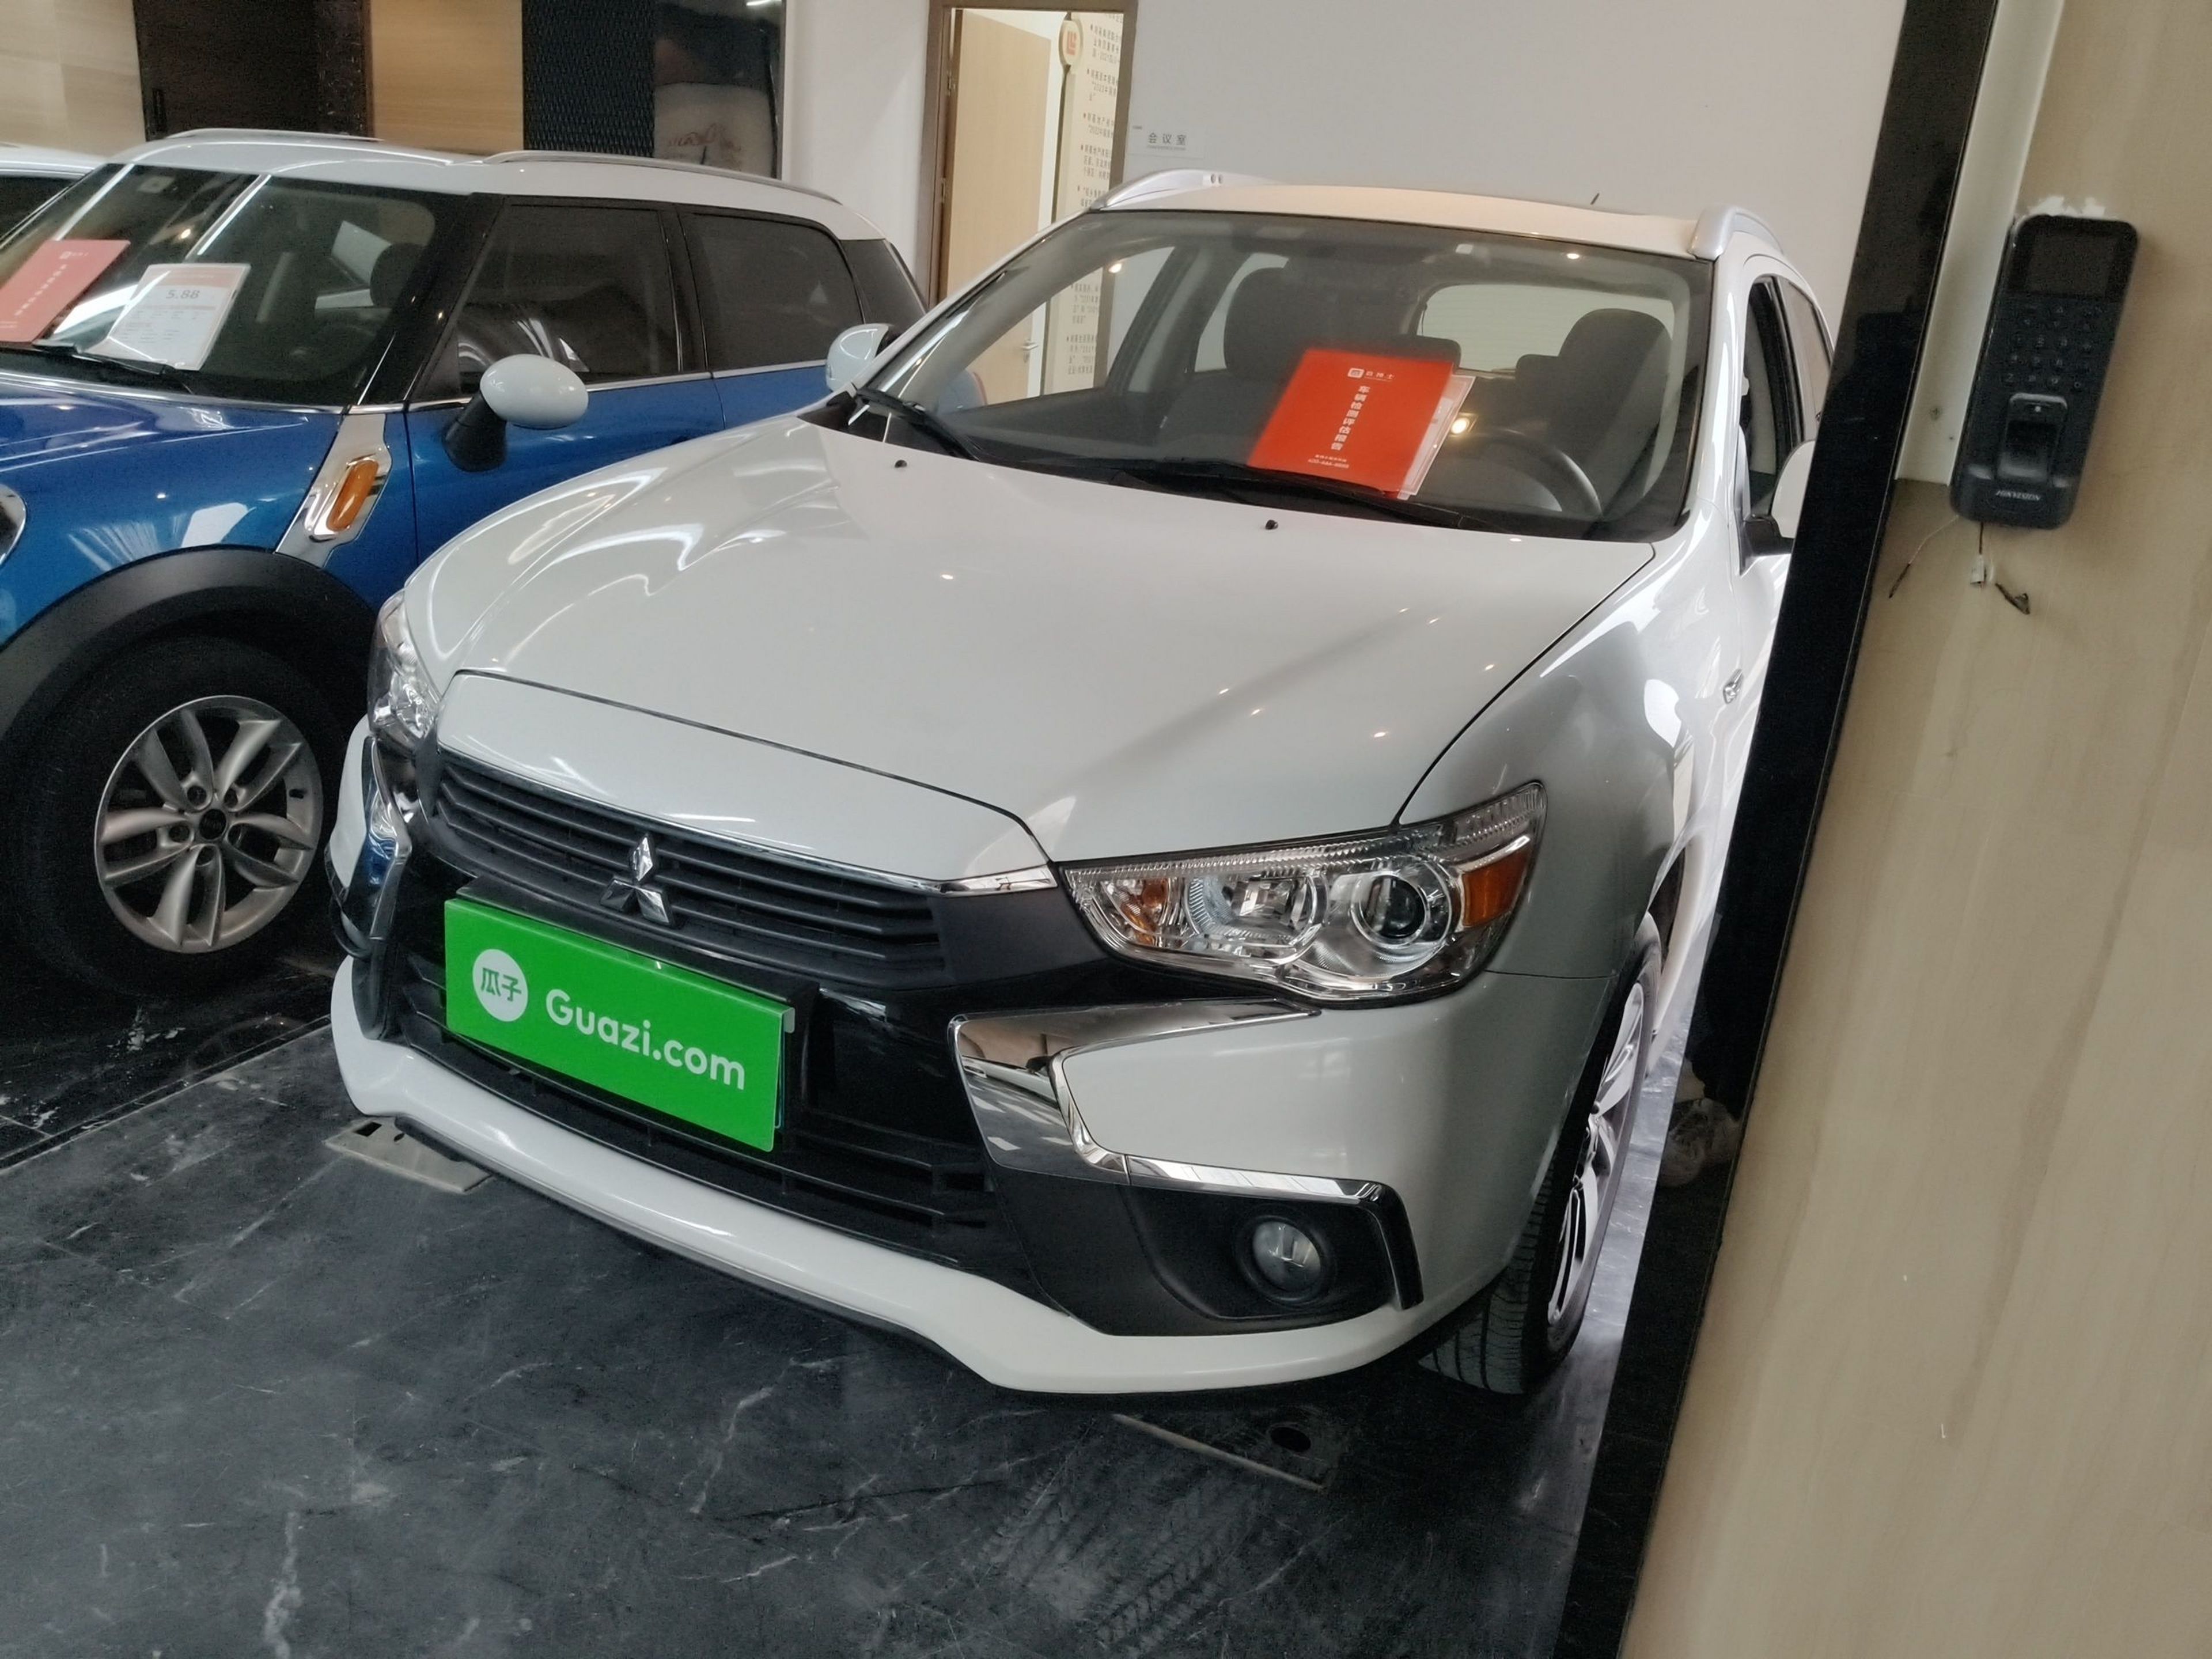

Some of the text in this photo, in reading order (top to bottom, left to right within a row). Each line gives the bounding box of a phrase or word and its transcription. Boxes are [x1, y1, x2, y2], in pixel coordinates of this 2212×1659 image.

[1149, 132, 1187, 145] 会议室
[165, 289, 200, 299] 5.88
[481, 967, 522, 1002] 瓜子
[546, 988, 745, 1090] Guazi.com
